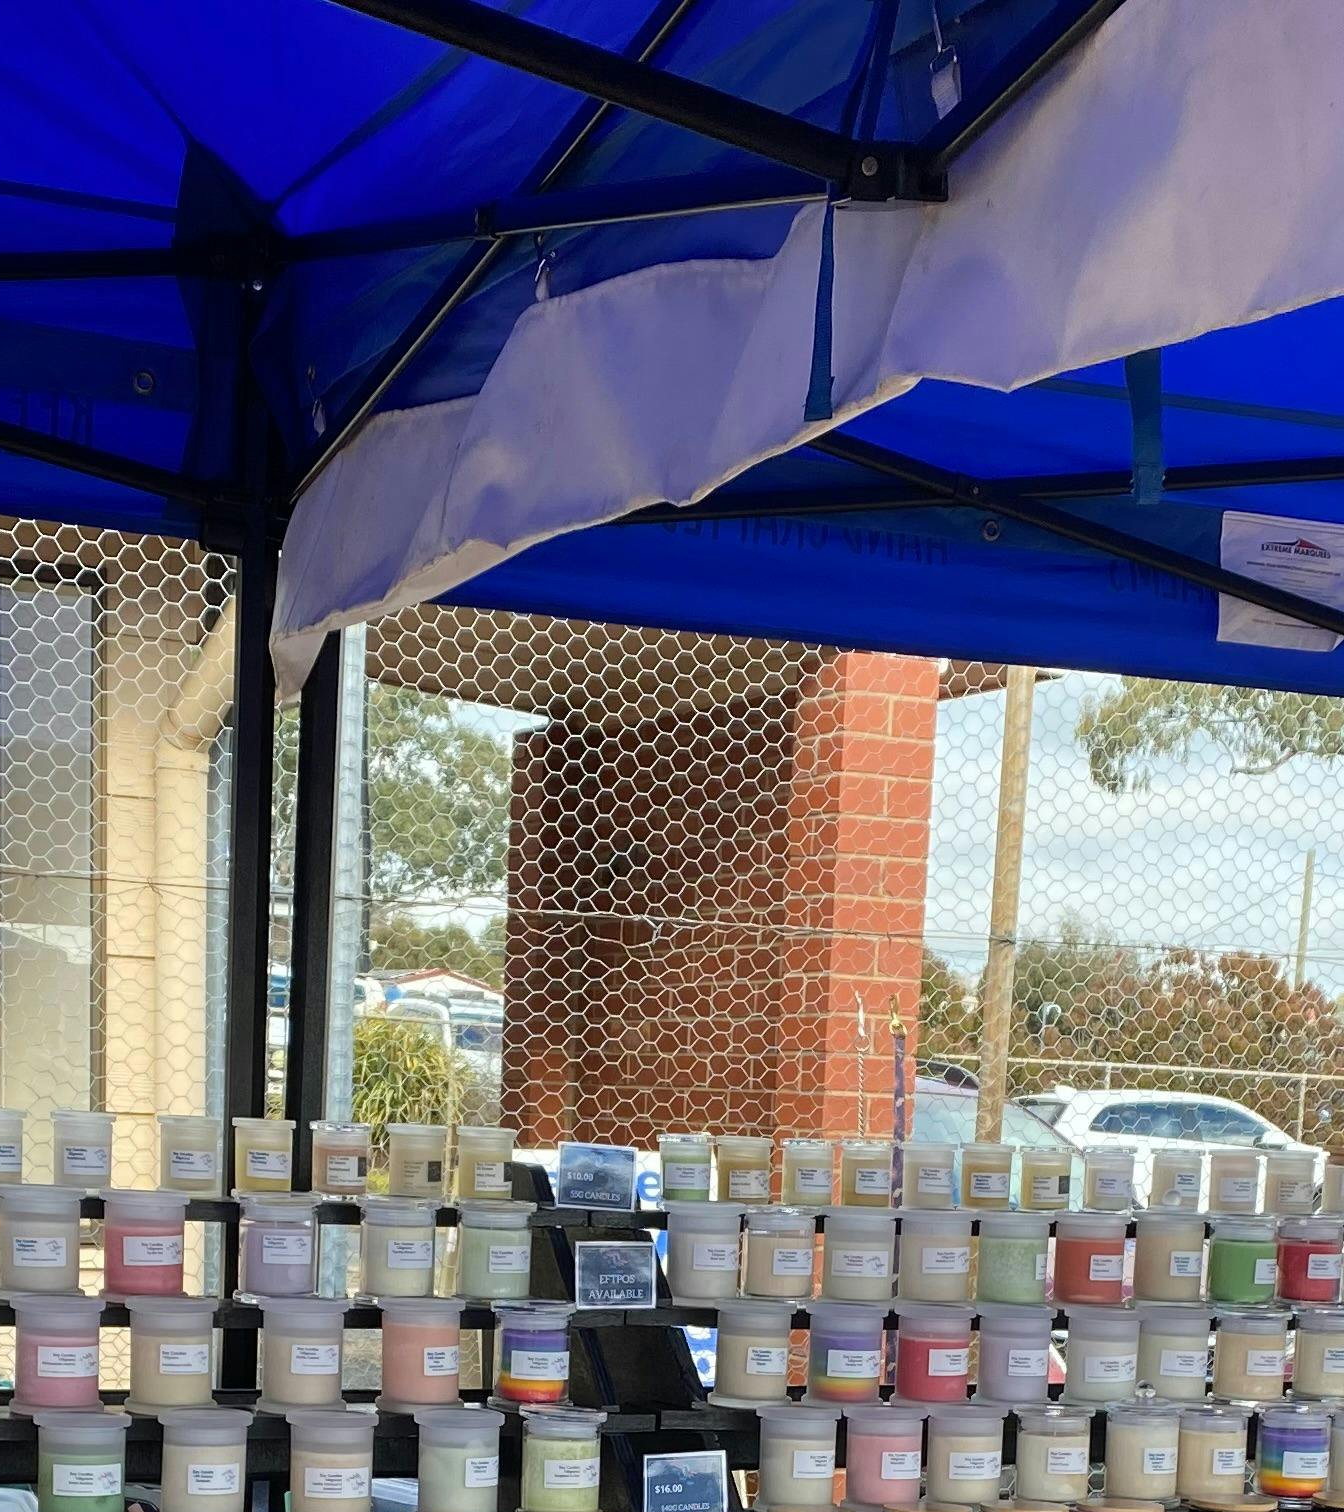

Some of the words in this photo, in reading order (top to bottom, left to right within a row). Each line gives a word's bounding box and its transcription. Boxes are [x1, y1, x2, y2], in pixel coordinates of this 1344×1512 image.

[1261, 543, 1293, 554] EXTREME
[585, 1190, 621, 1202] CANDLES
[599, 1274, 636, 1285] EFTPOS
[588, 1288, 644, 1300] AVAILABLE
[654, 1483, 683, 1494] $16.00
[678, 1503, 710, 1512] CANDLES
